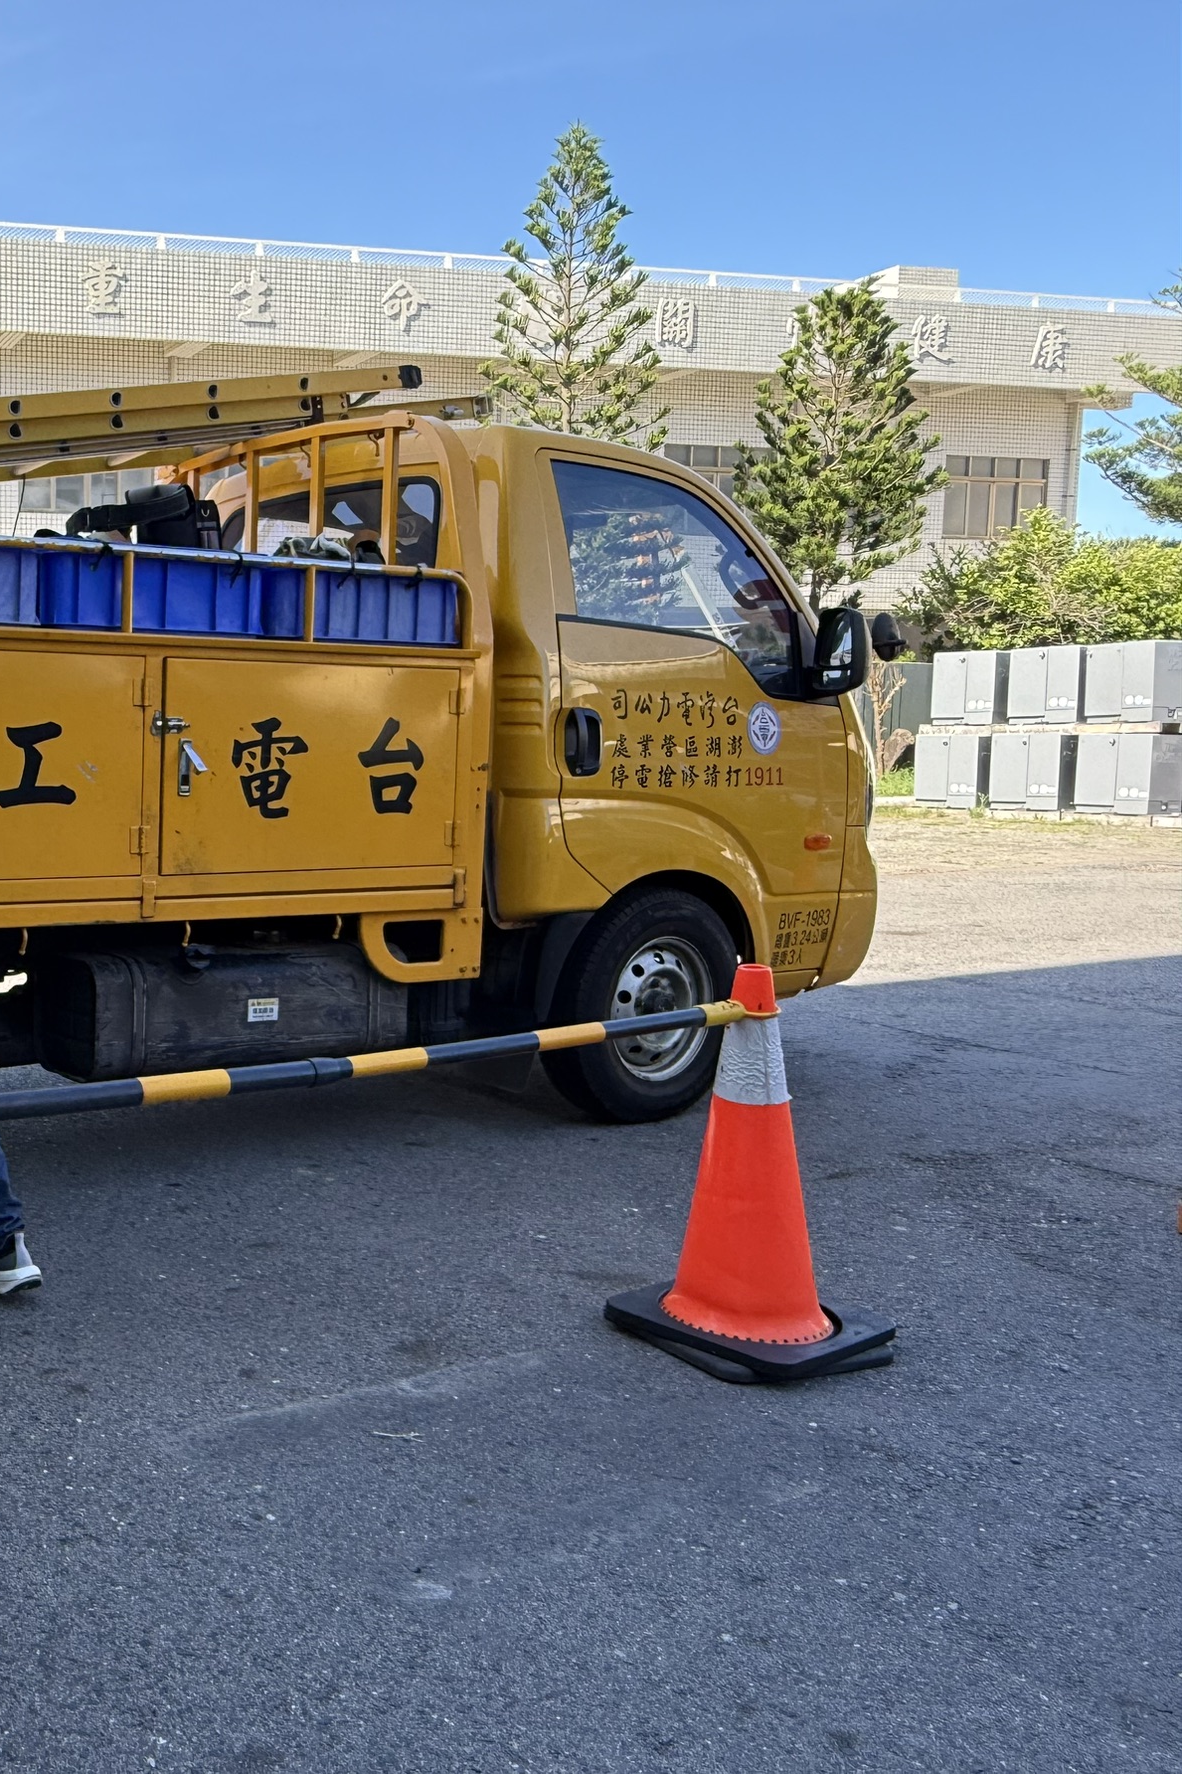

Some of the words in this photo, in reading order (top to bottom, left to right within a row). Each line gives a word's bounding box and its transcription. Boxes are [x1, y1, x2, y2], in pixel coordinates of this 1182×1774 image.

[655, 296, 1069, 370] 關健康
[778, 908, 831, 930] BVF-1983
